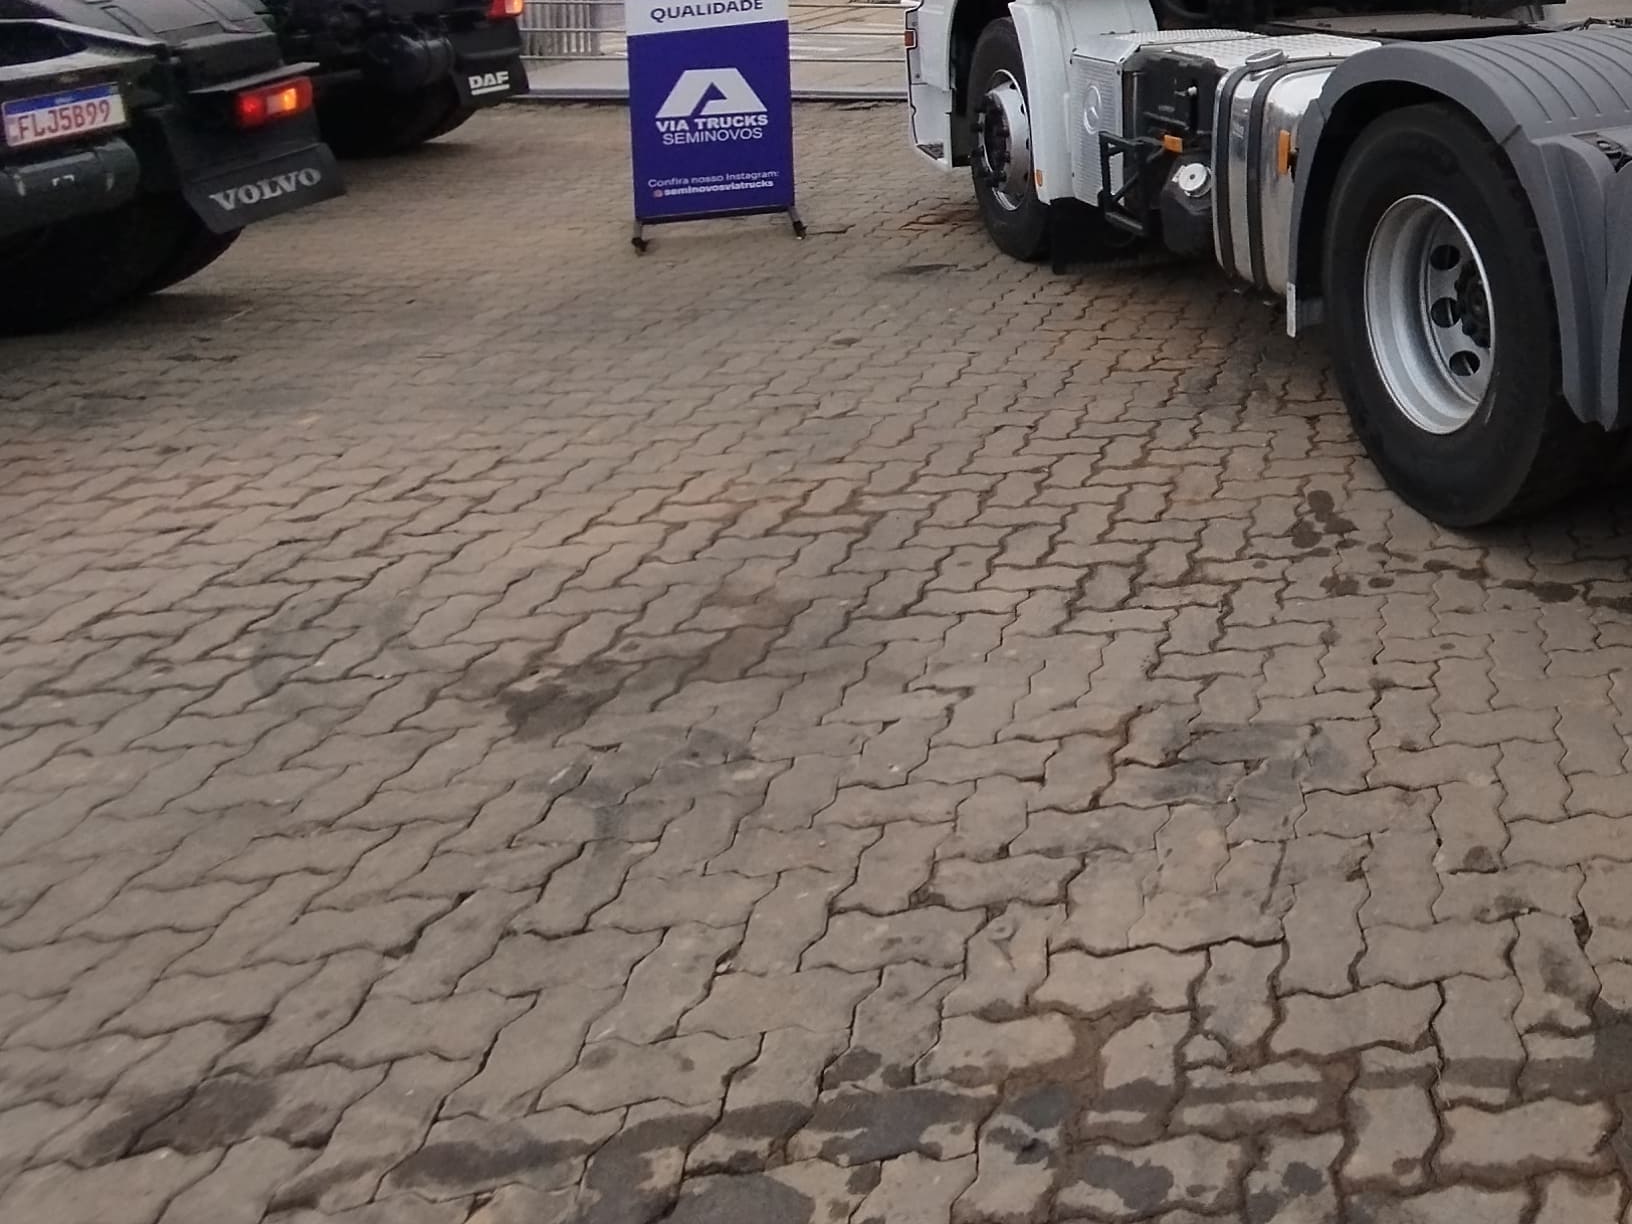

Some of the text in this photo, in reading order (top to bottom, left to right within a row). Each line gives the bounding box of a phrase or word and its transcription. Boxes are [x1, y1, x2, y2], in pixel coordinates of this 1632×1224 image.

[468, 71, 509, 89] DAF
[17, 101, 111, 140] FLJ5B99
[655, 114, 769, 133] VIA TRUCKS
[662, 127, 763, 146] SEMINOVOS
[209, 168, 321, 211] VOLVO
[648, 178, 689, 188] Confira
